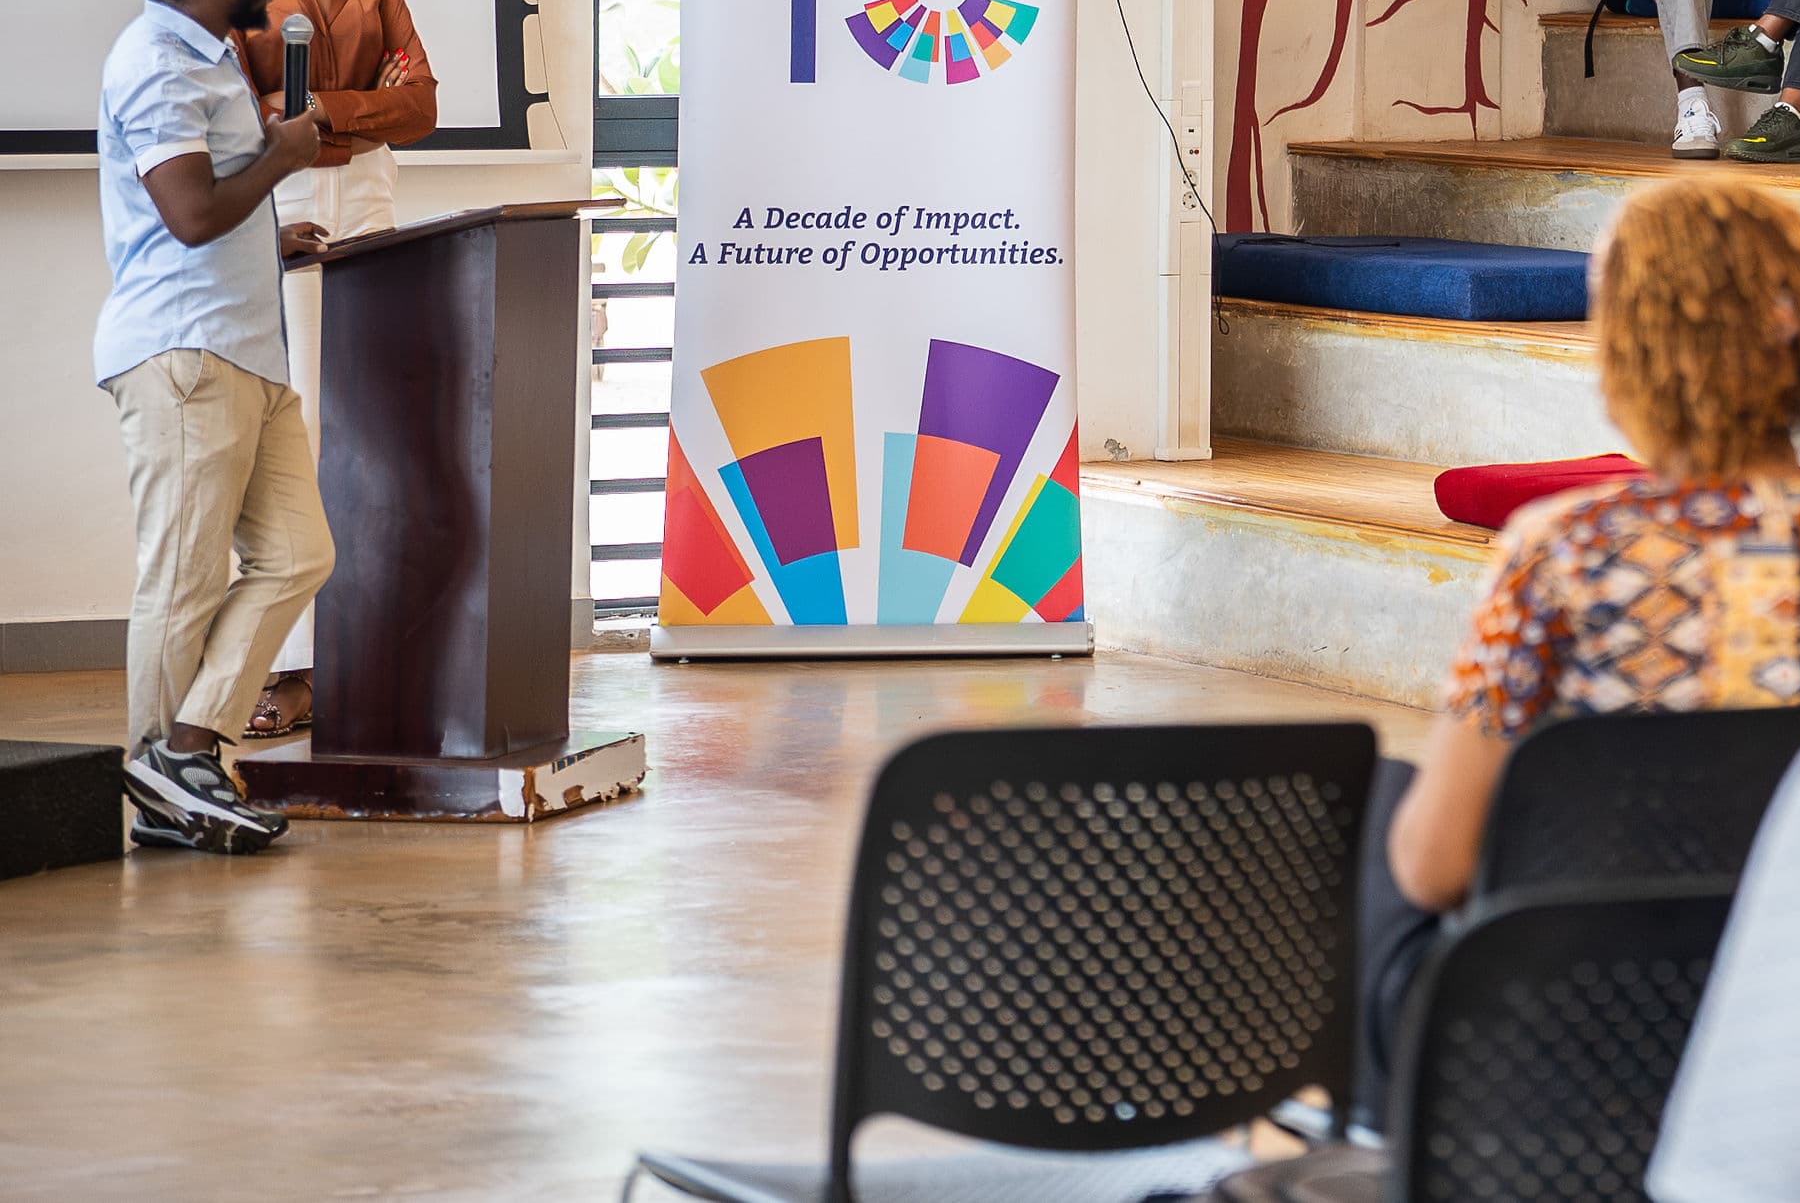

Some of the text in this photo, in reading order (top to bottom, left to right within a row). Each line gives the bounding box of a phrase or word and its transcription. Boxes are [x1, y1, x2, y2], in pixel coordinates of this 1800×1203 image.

[733, 205, 1021, 236] A Decade of Impact.
[688, 240, 1064, 271] A Future of Opportunities.
